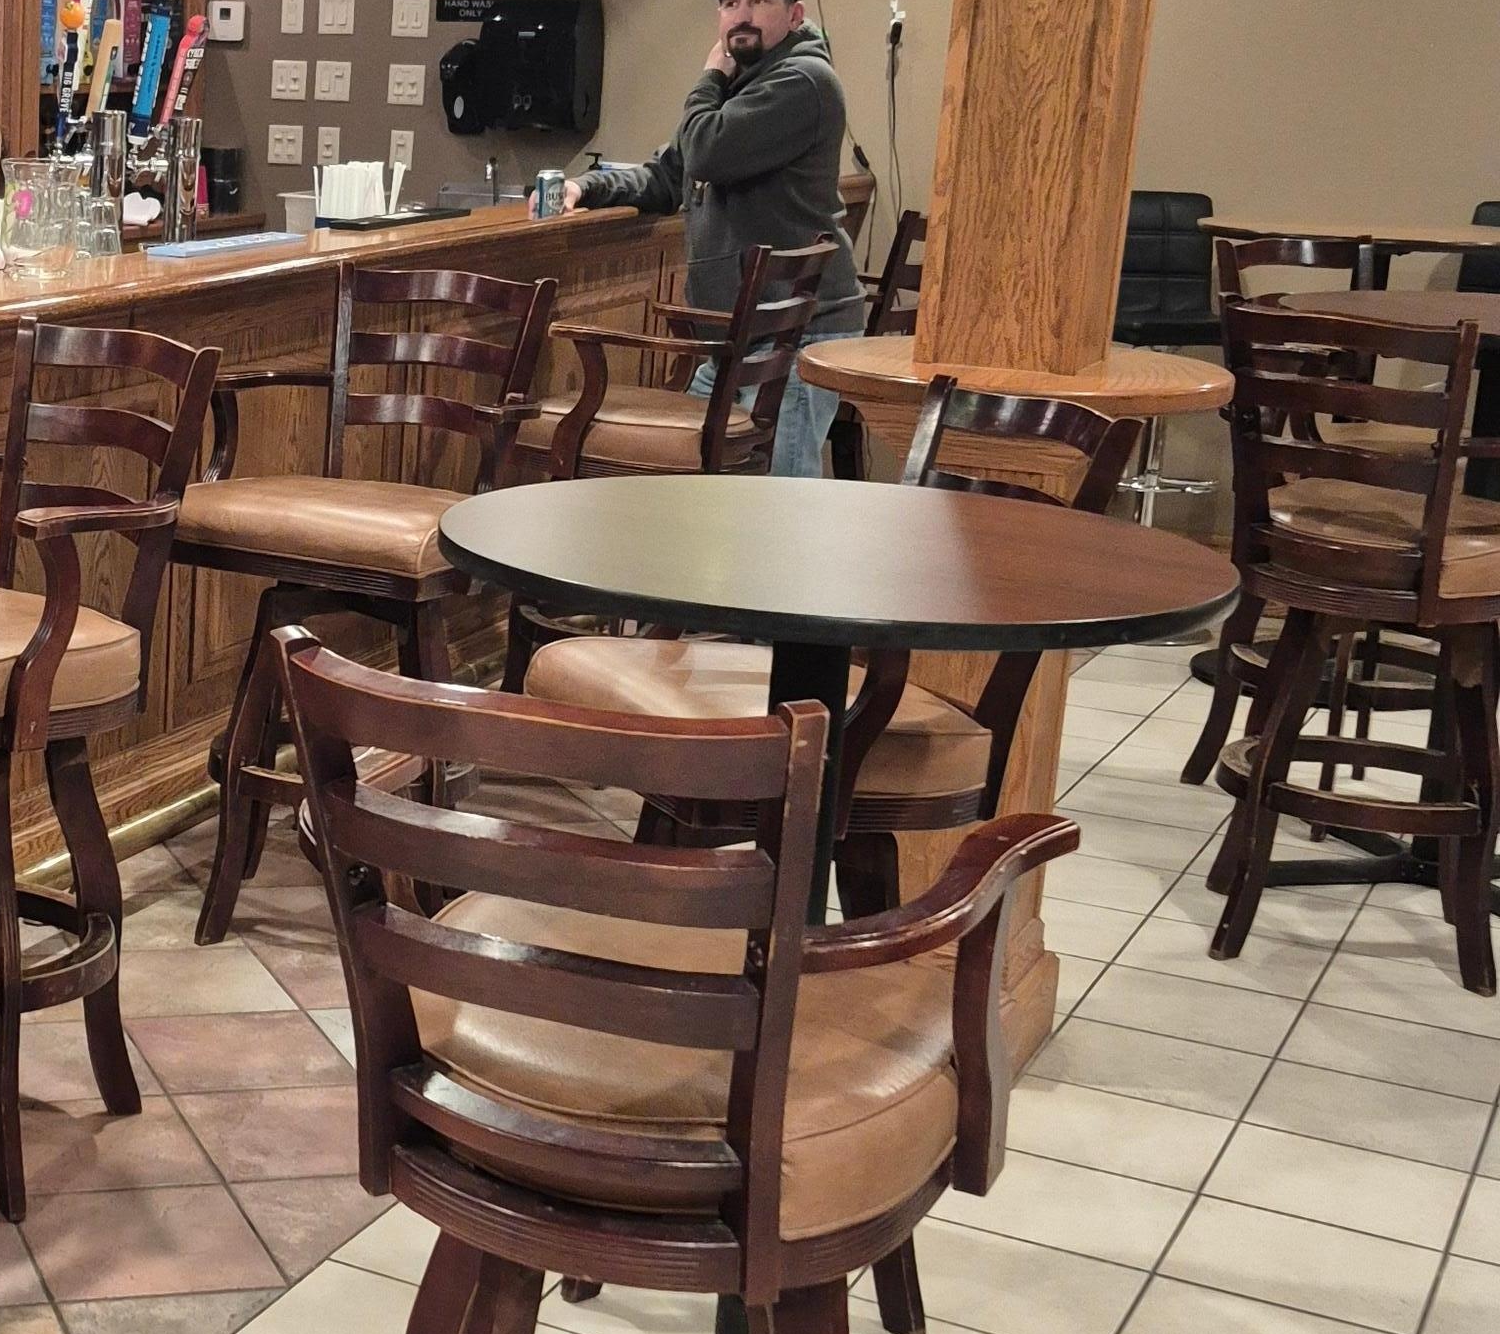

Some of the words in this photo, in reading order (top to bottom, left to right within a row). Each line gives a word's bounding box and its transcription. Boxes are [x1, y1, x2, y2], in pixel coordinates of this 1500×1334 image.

[444, 0, 470, 8] HAND
[471, 0, 495, 8] WAS
[459, 9, 482, 17] ONLY
[63, 71, 73, 86] BIG
[59, 85, 73, 113] GROVE
